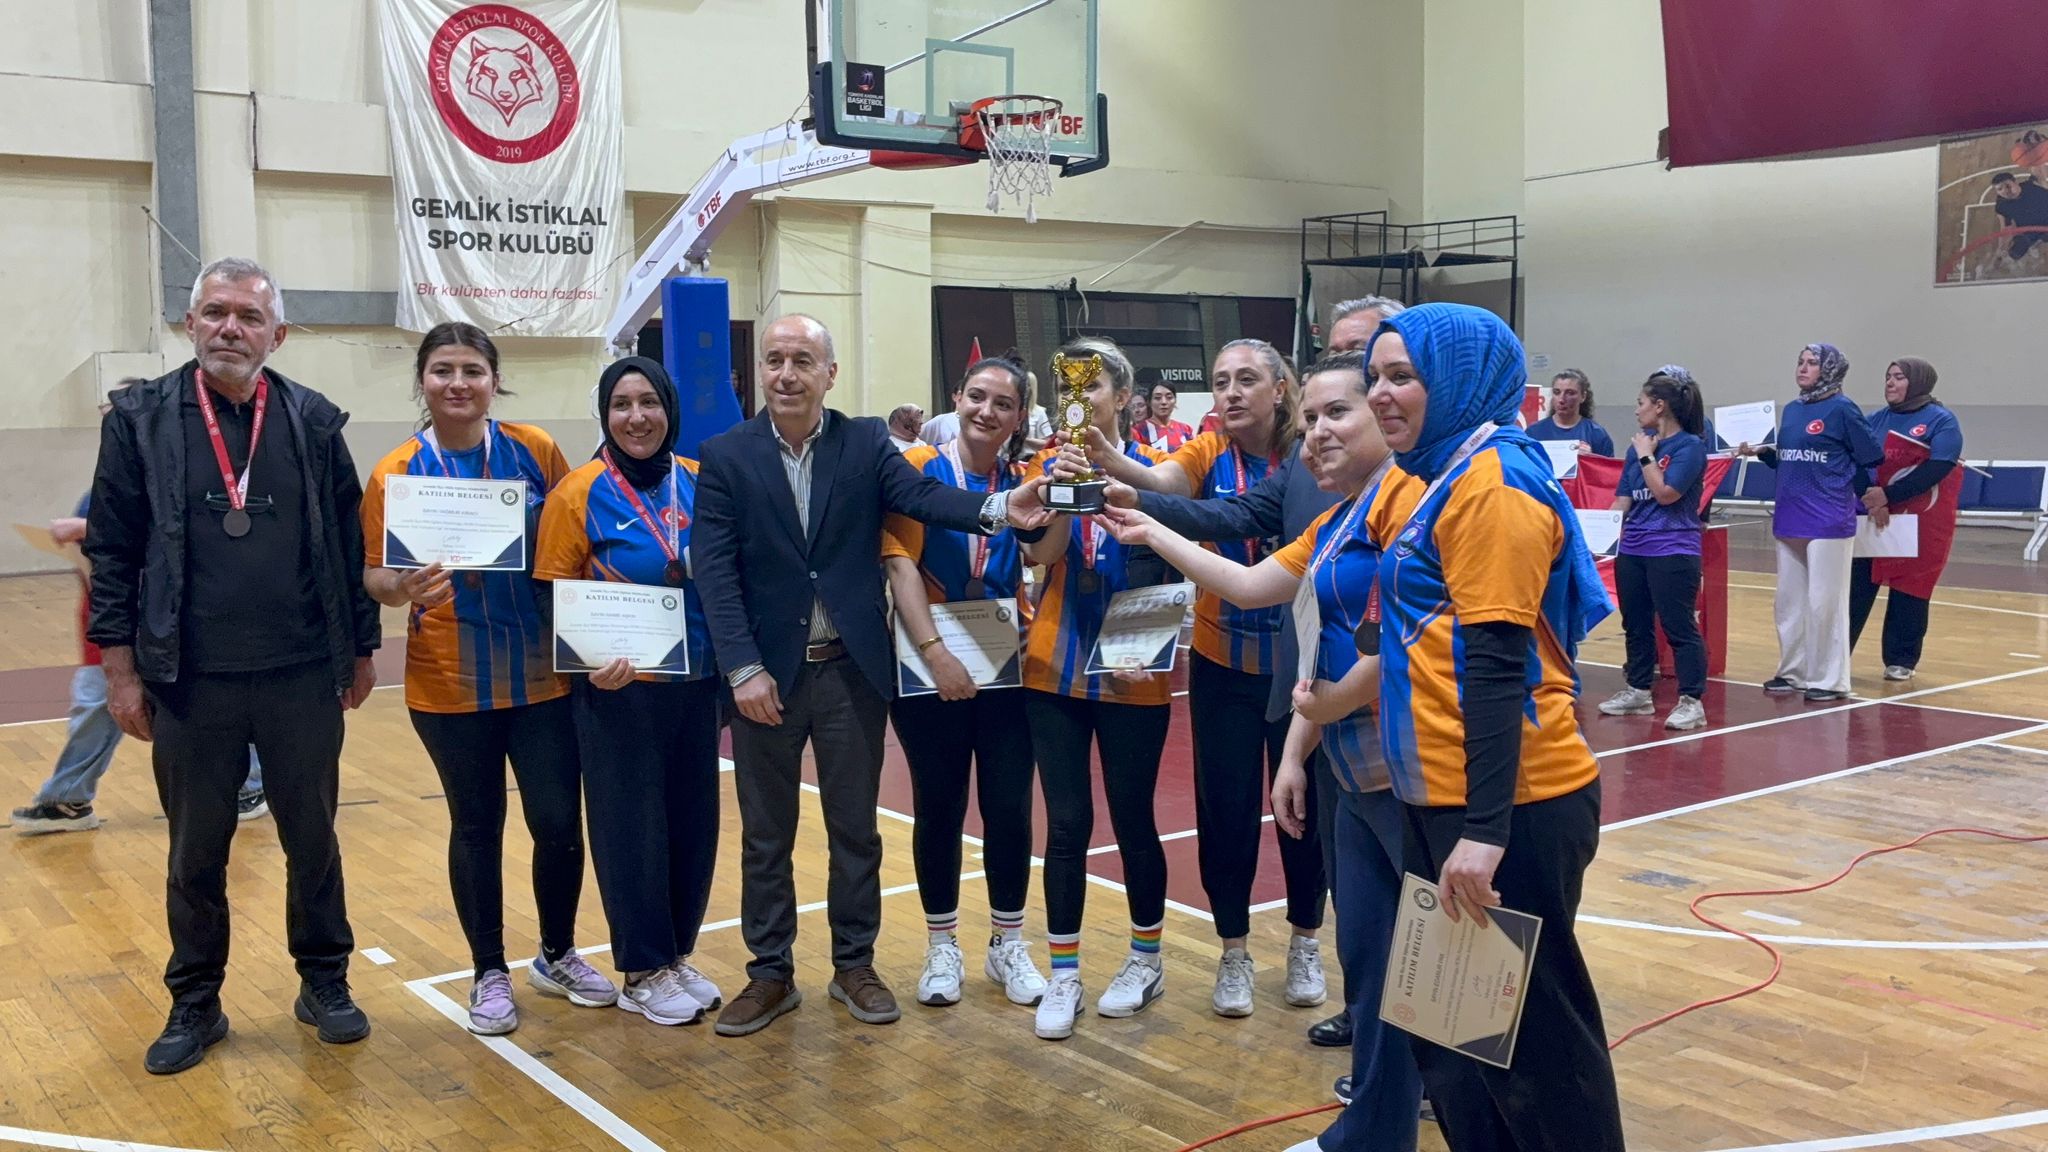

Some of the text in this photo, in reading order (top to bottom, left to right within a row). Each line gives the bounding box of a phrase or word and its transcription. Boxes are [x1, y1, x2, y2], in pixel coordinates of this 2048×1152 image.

[449, 12, 511, 39] İSTİKLAL
[514, 17, 546, 45] SPOR
[545, 43, 575, 104] KULÜBÜ
[847, 96, 884, 107] BASKETBOL
[496, 145, 523, 159] 2019
[411, 195, 608, 227] GEMLİK İSTİKLAL
[703, 190, 723, 220] TBF
[427, 229, 595, 255] SPOR KULÜBÜ
[441, 284, 507, 299] kulüpten
[510, 286, 548, 300] daha
[1160, 368, 1203, 381] VISITOR
[1411, 917, 1427, 952] BELGESİ
[1404, 954, 1419, 998] KATILIM
